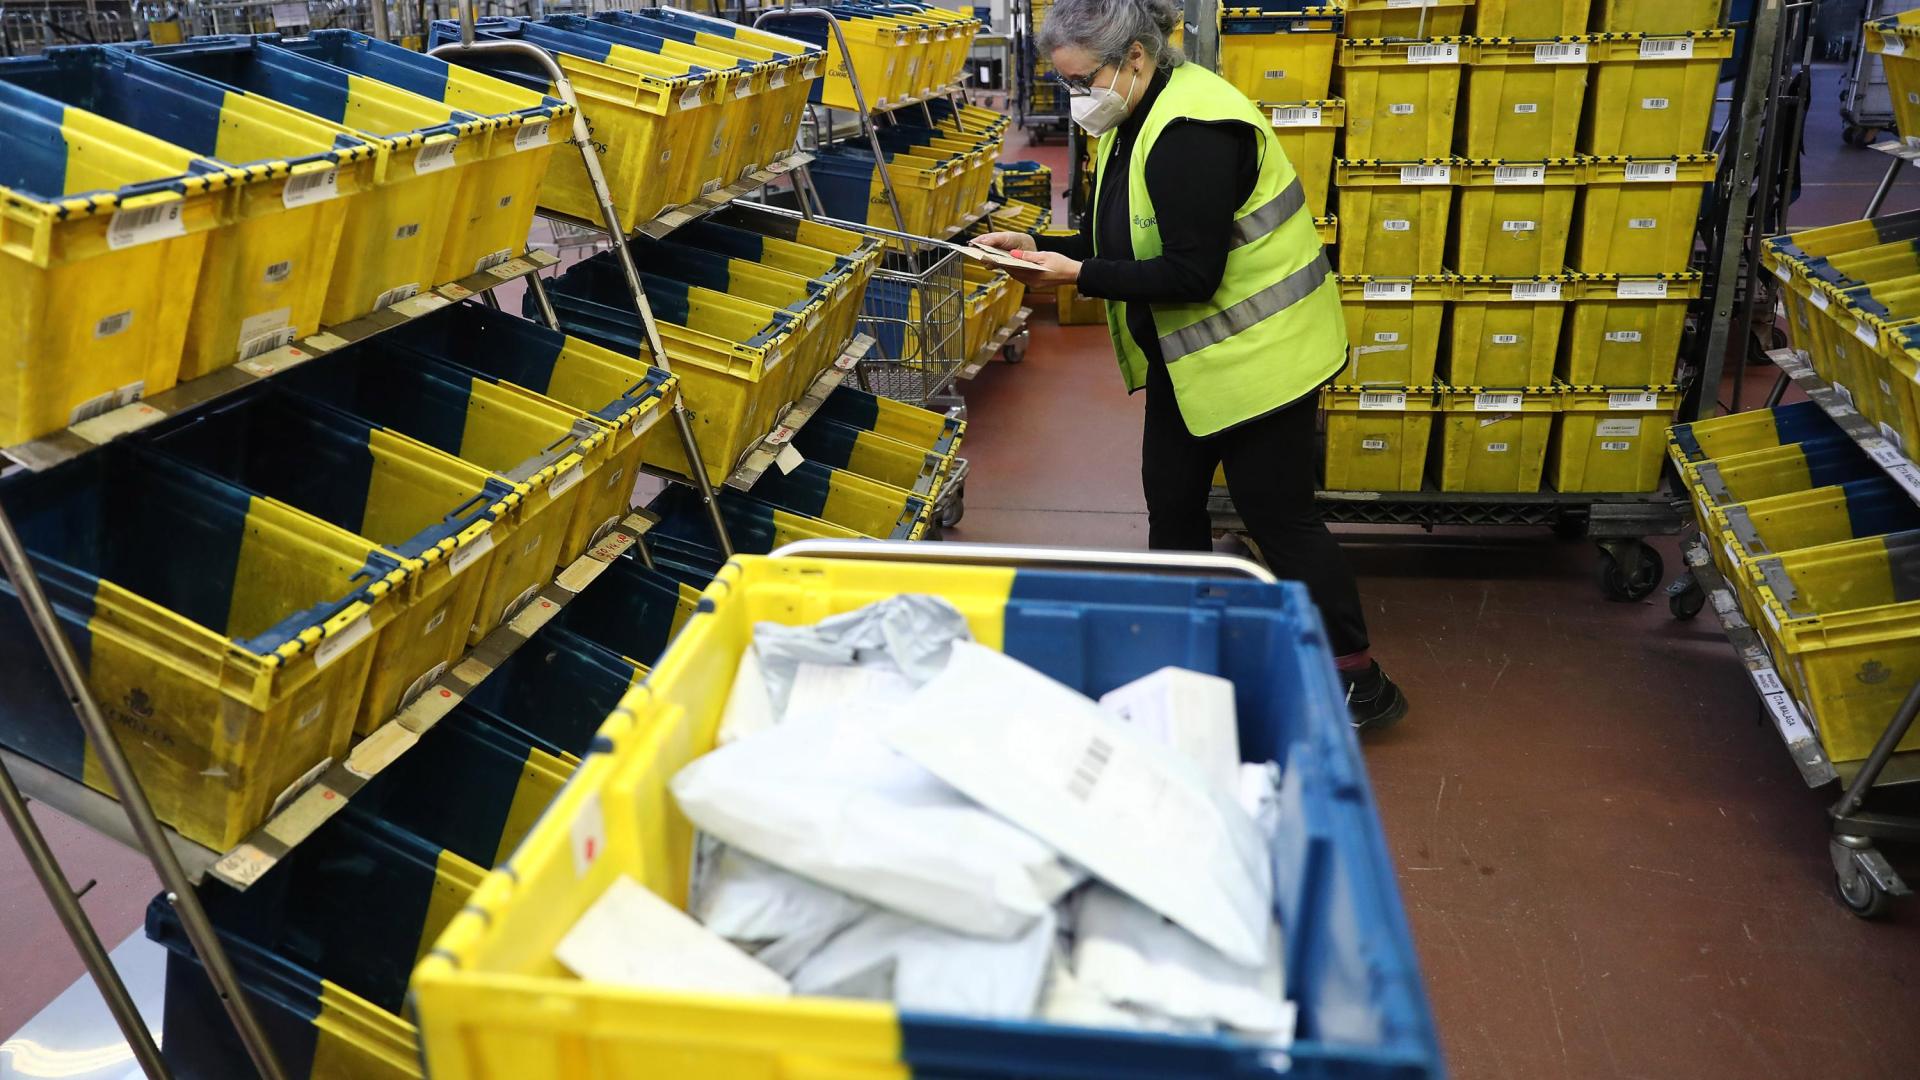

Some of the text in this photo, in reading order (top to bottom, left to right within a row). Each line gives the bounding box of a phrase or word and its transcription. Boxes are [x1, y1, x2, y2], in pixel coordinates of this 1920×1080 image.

[1574, 47, 1581, 55] B
[1680, 43, 1687, 51] B
[1446, 48, 1452, 56] B
[1440, 169, 1445, 177] B
[1664, 166, 1670, 174] B
[1780, 704, 1796, 727] MALAGA
